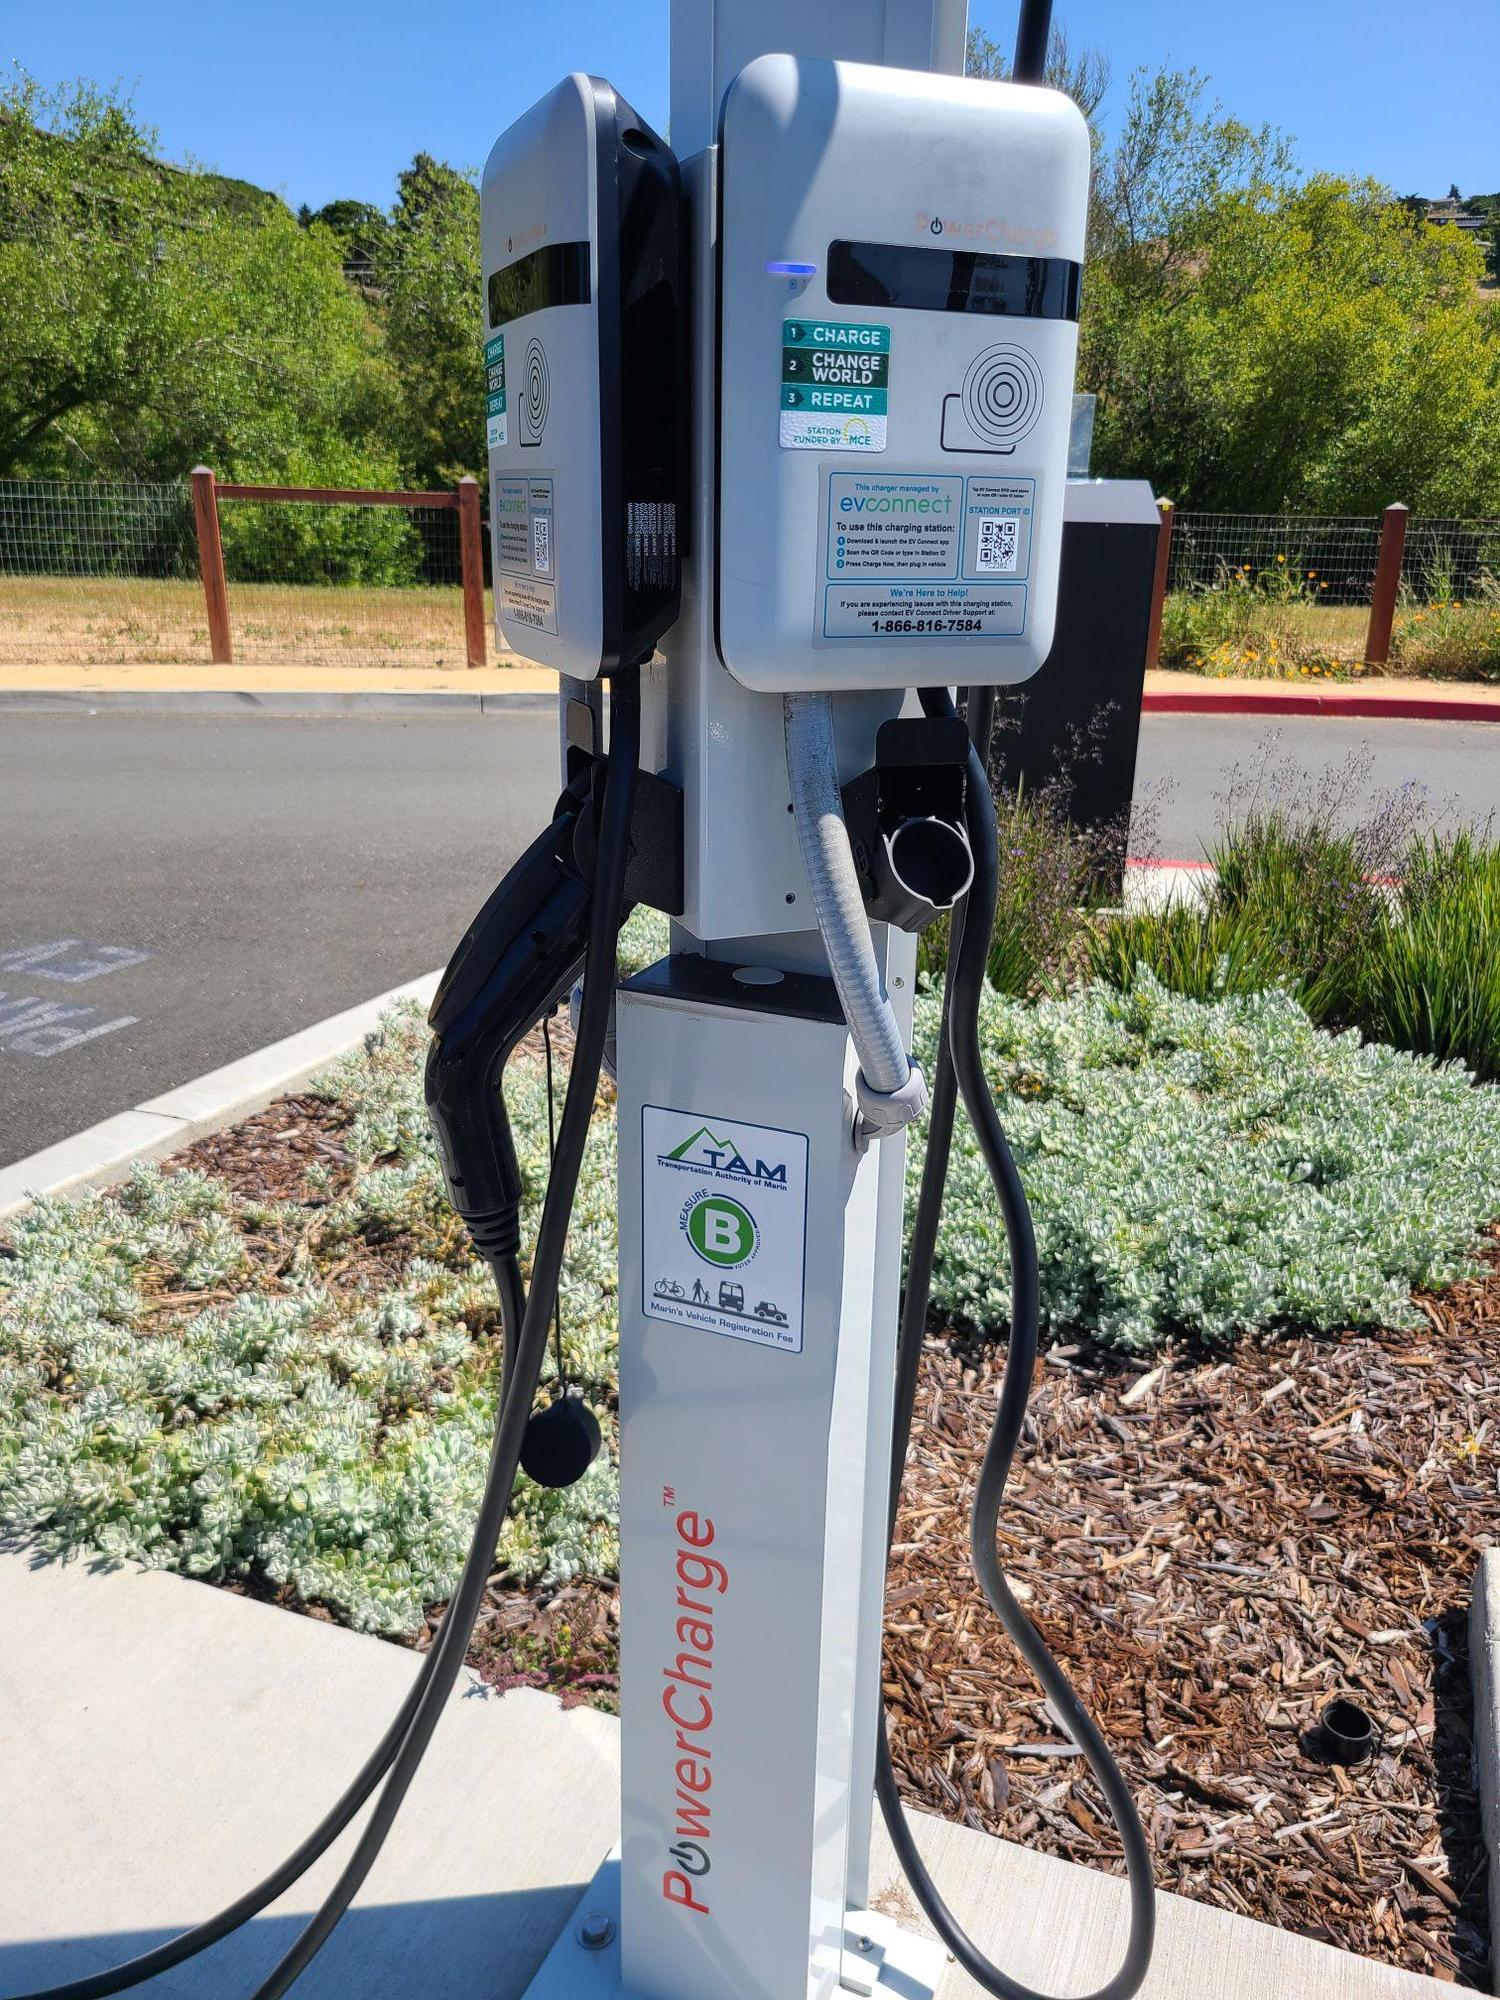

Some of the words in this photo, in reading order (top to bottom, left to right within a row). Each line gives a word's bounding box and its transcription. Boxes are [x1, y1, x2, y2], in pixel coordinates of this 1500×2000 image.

[812, 328, 881, 346] CHARGE
[789, 360, 796, 370] 2
[812, 352, 880, 370] CHANGE
[812, 367, 874, 385] WORLD
[788, 392, 796, 404] 3
[811, 392, 873, 409] REPEAT
[806, 426, 841, 436] STATION
[794, 436, 827, 445] FUNDED
[828, 436, 841, 446] BY
[848, 435, 872, 446] MCE
[872, 484, 898, 493] charger
[900, 486, 930, 494] managed
[968, 506, 1000, 514] STATION
[1001, 507, 1021, 515] PORT
[836, 522, 846, 531] To
[849, 523, 865, 531] use
[867, 522, 883, 531] this
[885, 523, 922, 534] charging
[924, 524, 955, 533] station:
[890, 589, 913, 597] We're
[916, 589, 935, 597] Here
[947, 589, 968, 598] Help!
[963, 601, 990, 609] charging
[872, 619, 982, 632] 1-866-816-7584
[702, 1148, 787, 1184] TAM
[657, 1159, 713, 1178] Transportation
[715, 1170, 752, 1186] Authority
[754, 1178, 762, 1187] of
[763, 1180, 788, 1192] Marin
[680, 1188, 710, 1231] MEASURE
[704, 1208, 742, 1254] B
[650, 1301, 683, 1318] Marin's
[685, 1310, 717, 1325] Vehicle
[719, 1318, 774, 1340] Registration
[777, 1330, 794, 1344] Fee
[662, 1509, 729, 1915] PowerCharge
